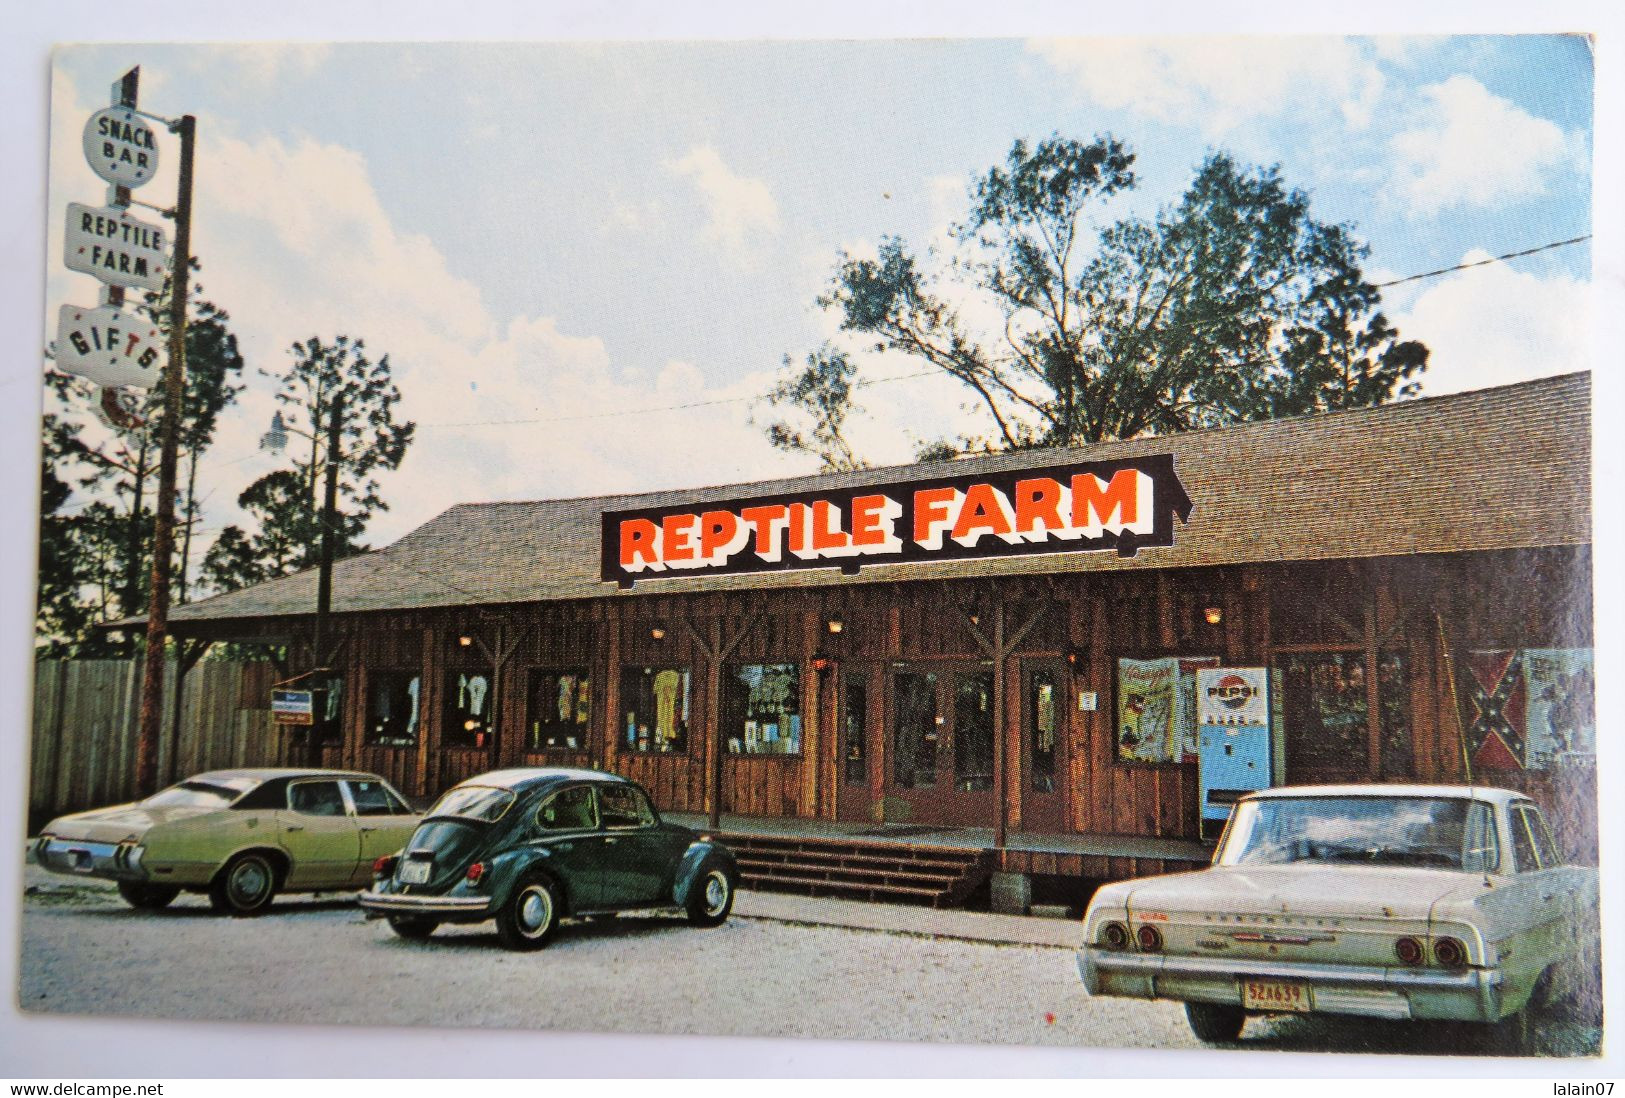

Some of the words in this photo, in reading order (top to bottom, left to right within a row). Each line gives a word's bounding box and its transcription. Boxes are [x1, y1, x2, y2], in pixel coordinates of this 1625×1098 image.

[98, 116, 154, 150] SNACK
[103, 141, 148, 169] BAR
[82, 212, 161, 251] REPTILE
[91, 244, 148, 277] FARM
[69, 325, 158, 369] GIFTS
[620, 493, 901, 573] REPTILE
[913, 468, 1154, 549] FARM
[1207, 686, 1258, 698] PEPSI
